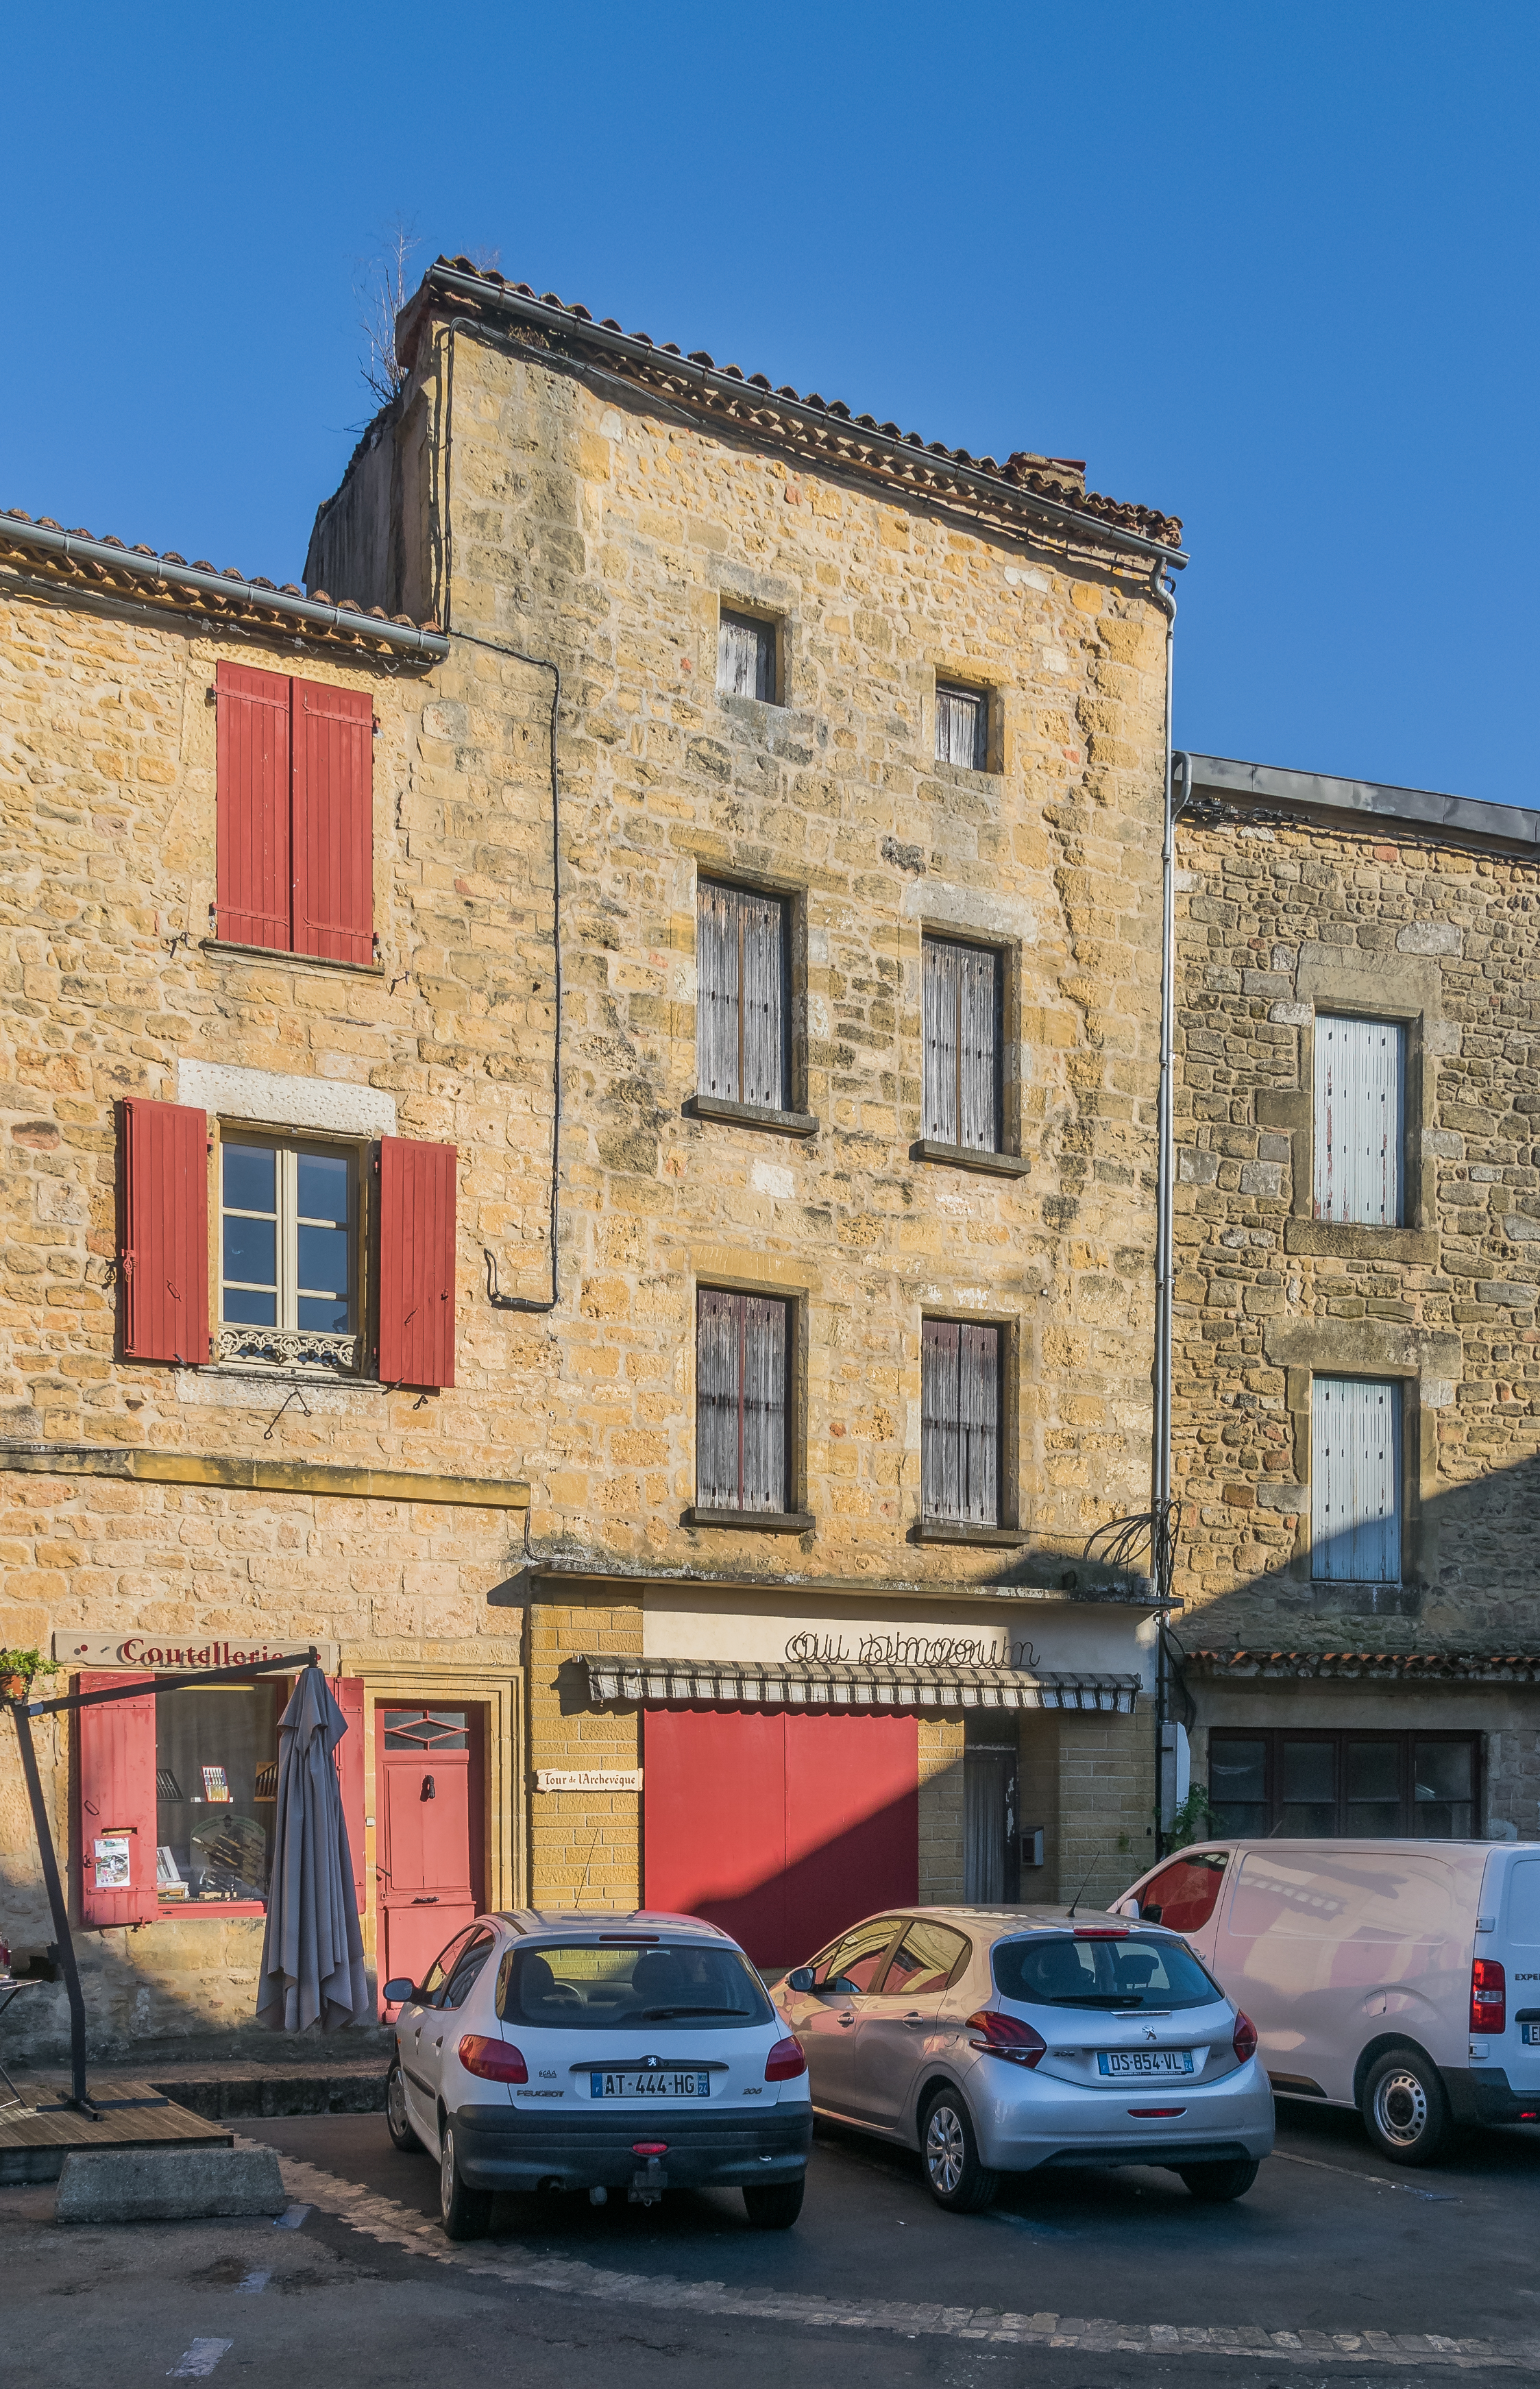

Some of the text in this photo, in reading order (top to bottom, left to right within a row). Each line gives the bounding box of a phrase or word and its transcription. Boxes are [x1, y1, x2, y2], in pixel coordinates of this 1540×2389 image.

[545, 1773, 567, 1785] Tour
[578, 1773, 635, 1788] l'Archevêque
[1532, 2026, 1540, 2041] E
[1110, 2053, 1182, 2071] DS-854-VL
[1184, 2062, 1193, 2070] 24
[605, 2074, 695, 2094] AT-444-HG
[698, 2085, 707, 2094] 24
[517, 2089, 565, 2098] PEUGEOT
[742, 2087, 763, 2096] 206
